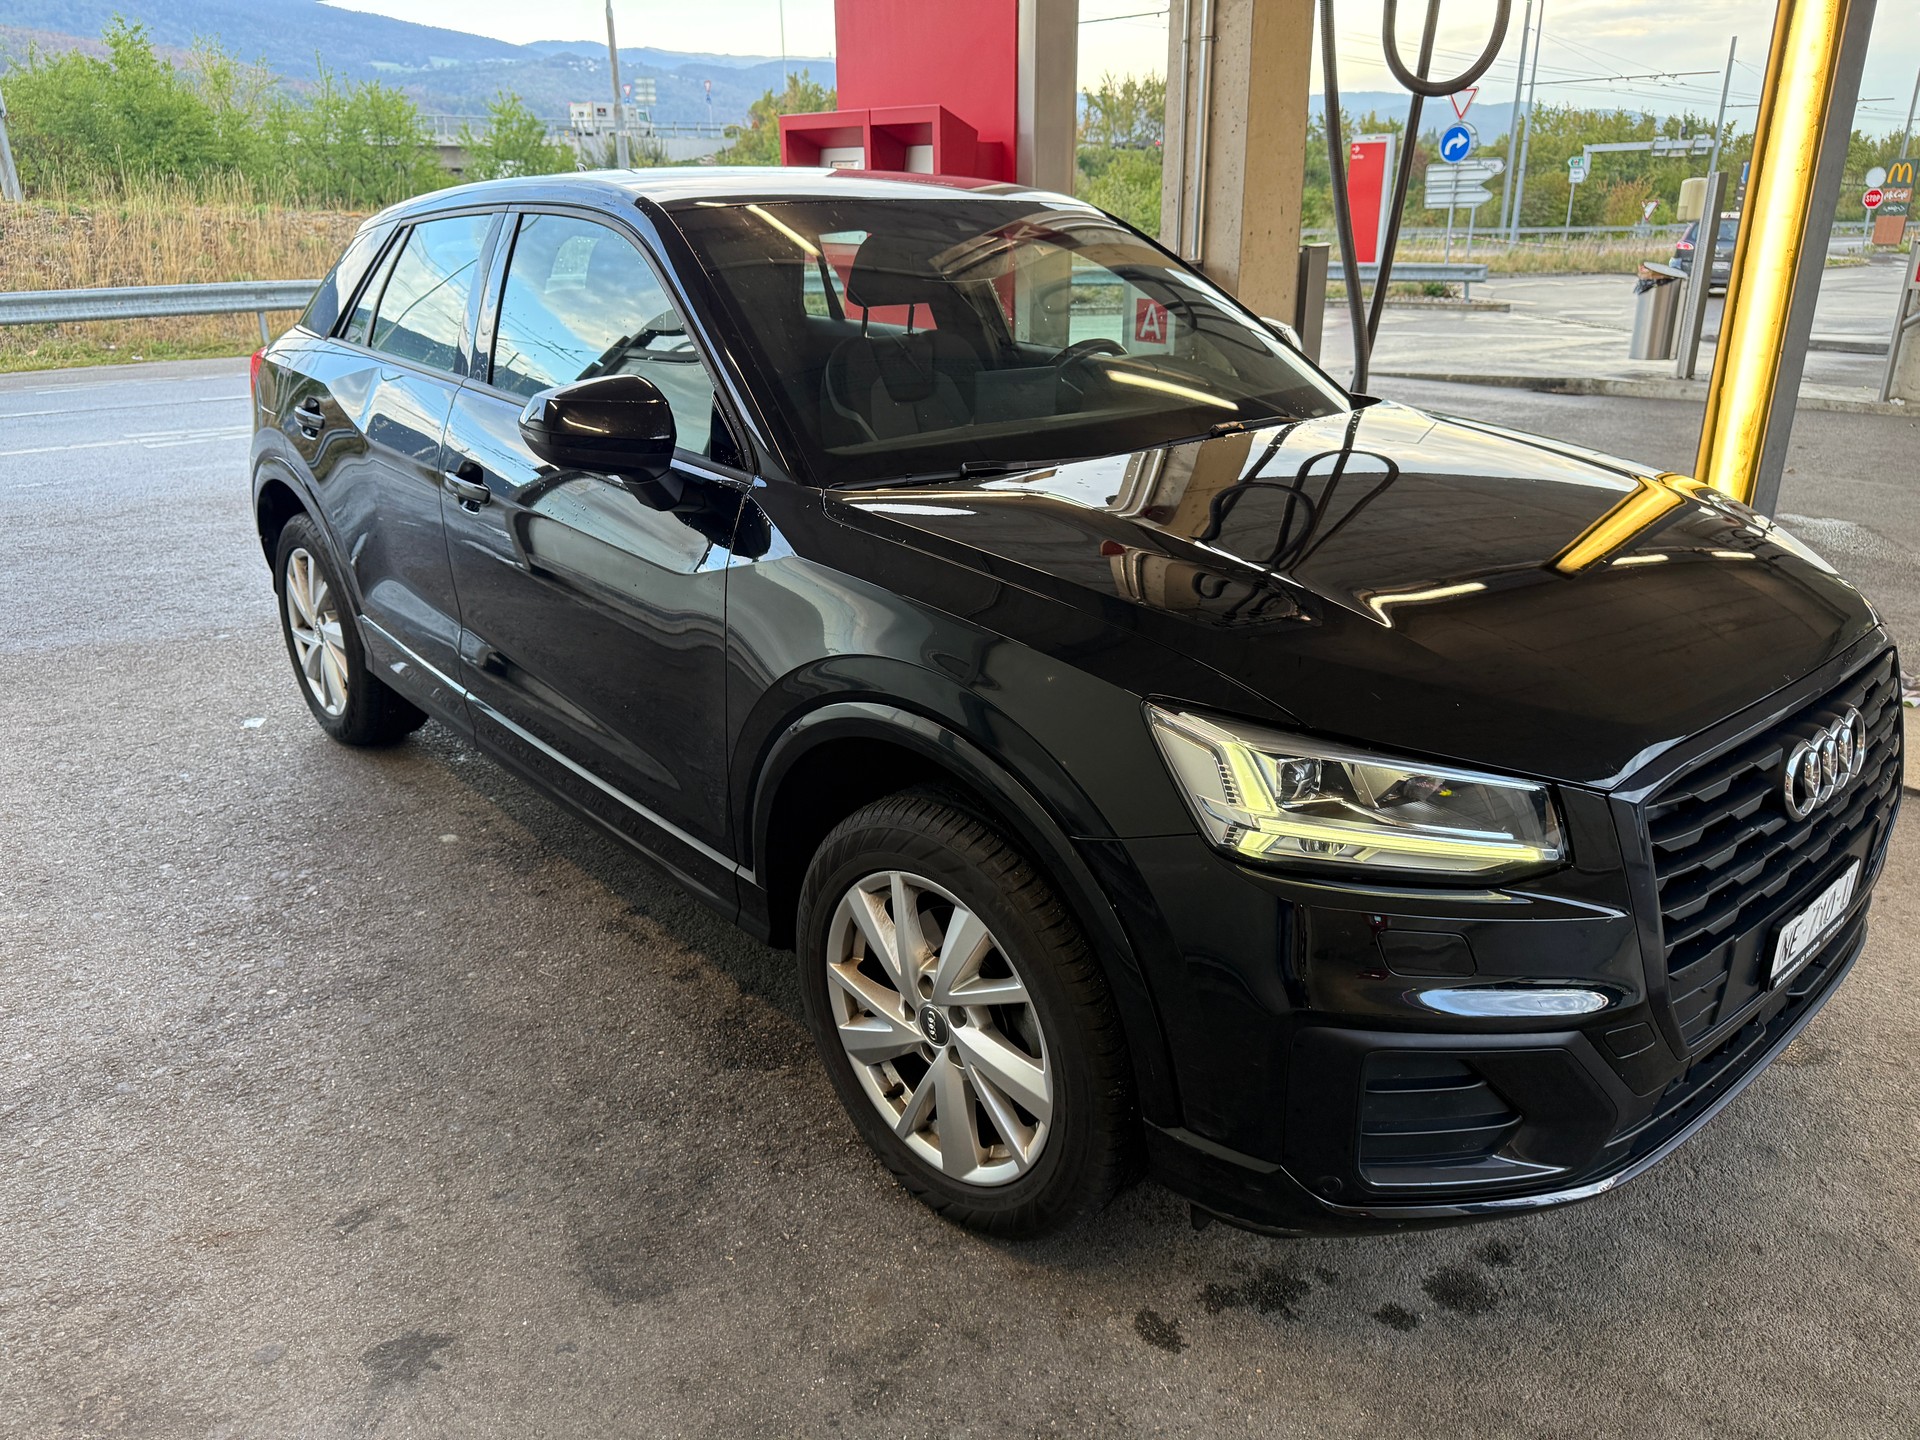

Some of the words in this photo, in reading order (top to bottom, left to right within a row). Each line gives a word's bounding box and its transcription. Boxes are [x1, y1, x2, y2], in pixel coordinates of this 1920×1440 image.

[1887, 162, 1913, 184] M
[1865, 194, 1881, 203] STOP
[1140, 303, 1161, 340] A
